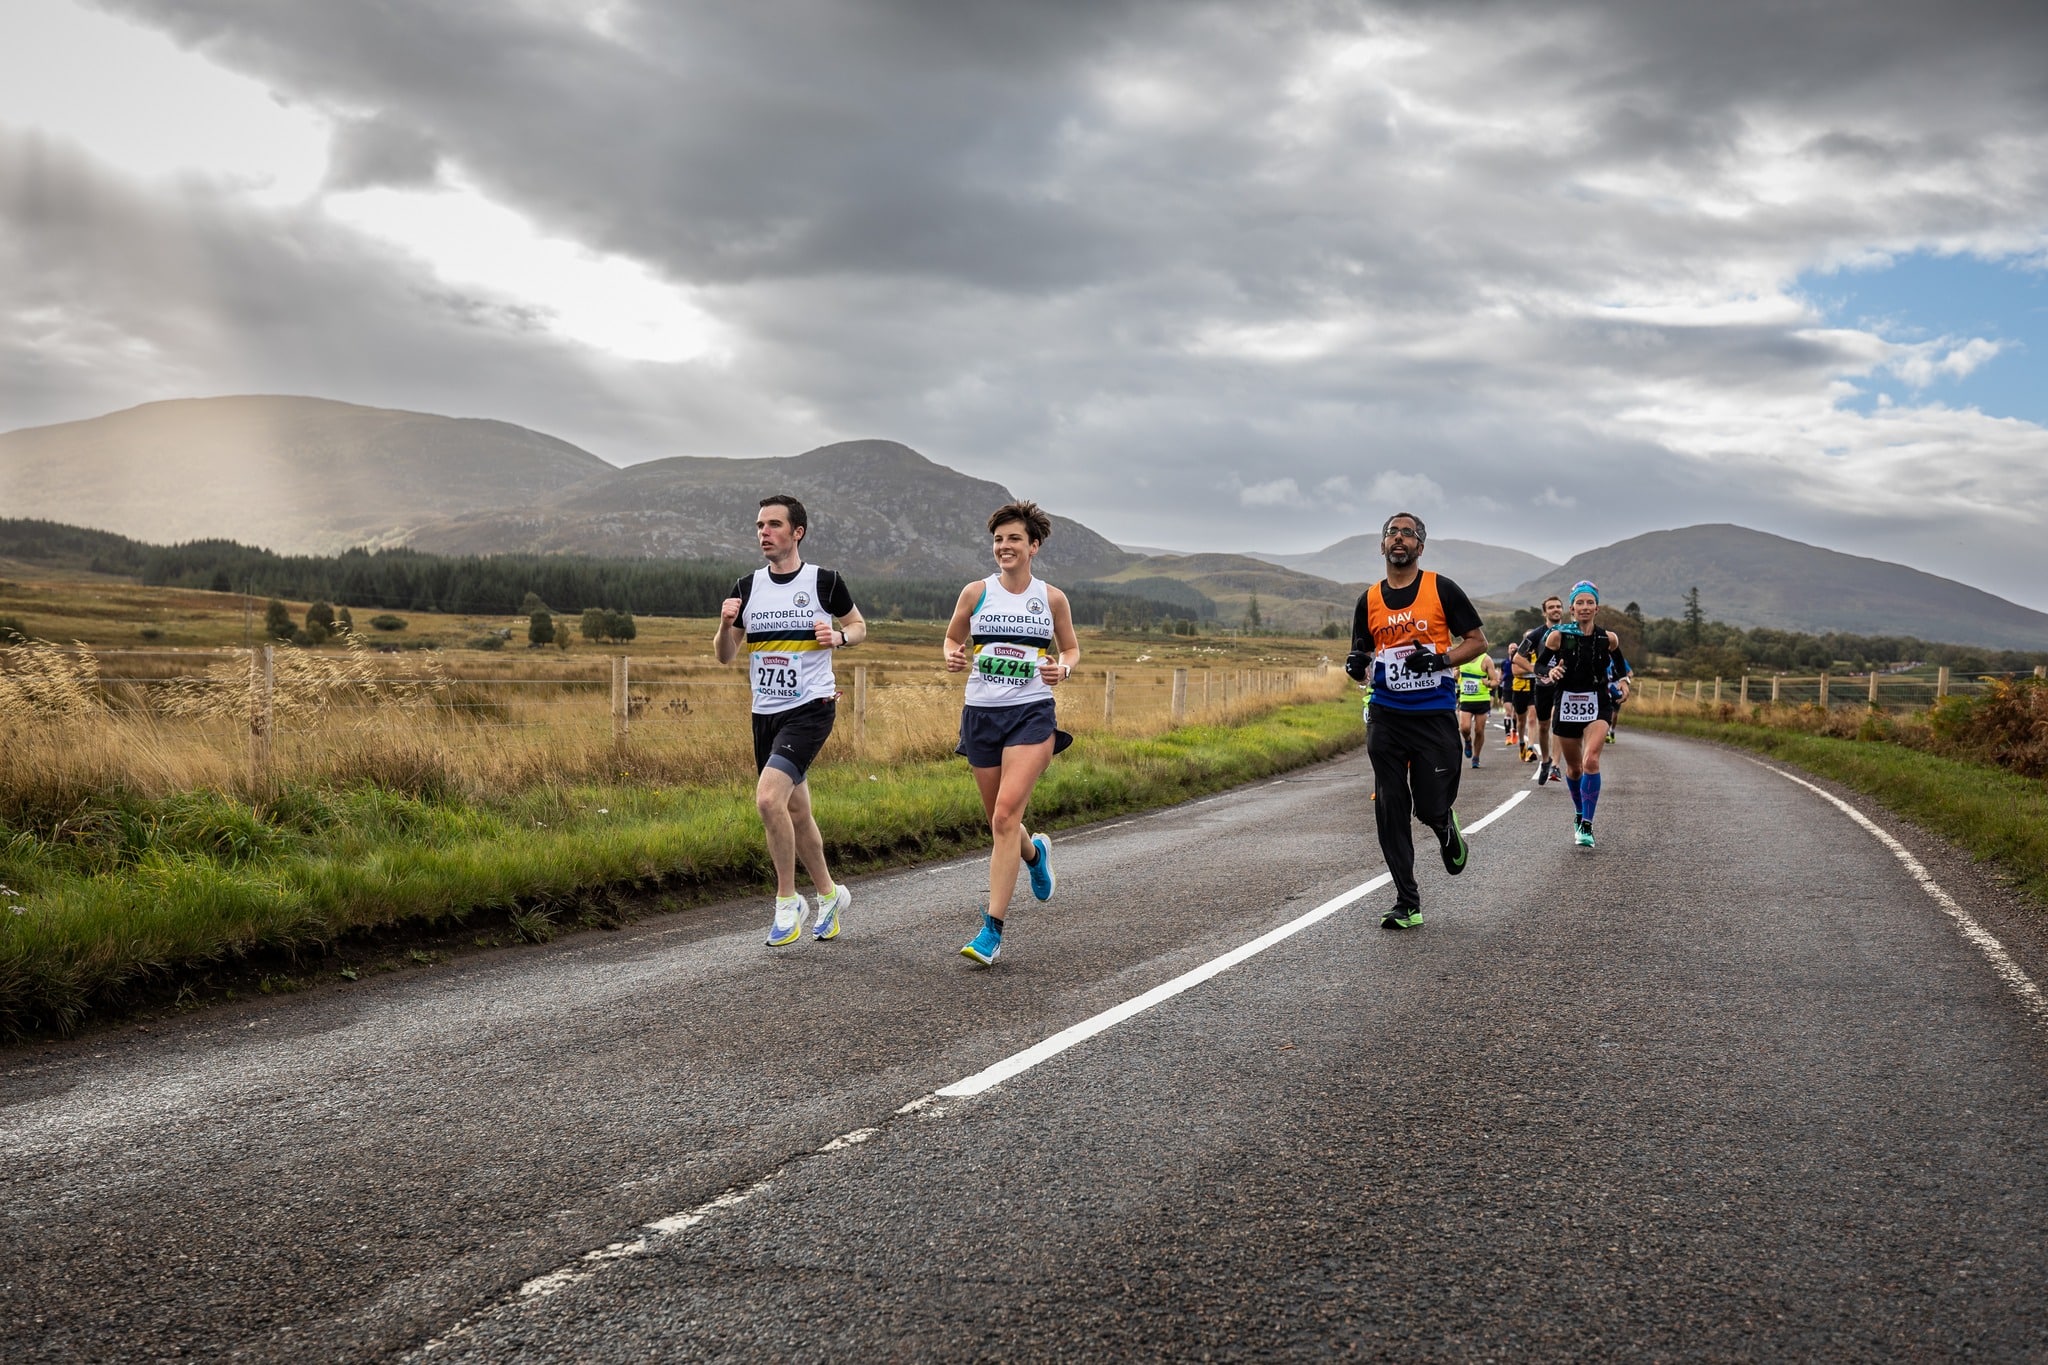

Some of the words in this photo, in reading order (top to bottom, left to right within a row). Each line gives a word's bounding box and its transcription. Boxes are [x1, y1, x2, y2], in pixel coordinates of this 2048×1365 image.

[751, 610, 814, 620] PORTOBELLO
[979, 614, 1050, 626] PORTOBELLO
[1388, 610, 1412, 625] NAV
[751, 621, 788, 631] RUNNING
[790, 620, 814, 629] CLUB
[979, 625, 1024, 634] RUNNING
[1026, 626, 1050, 636] CLUB
[1380, 618, 1428, 636] mnda
[995, 647, 1025, 659] Baxters
[982, 657, 1031, 678] 4294
[758, 667, 797, 688] 2743
[983, 674, 1005, 684] LOCH
[1007, 677, 1029, 686] NESS
[1391, 682, 1412, 690] LOCH
[1415, 679, 1435, 688] NESS
[760, 688, 776, 696] LOCH
[778, 689, 797, 697] NESS
[1563, 702, 1595, 715] 3358
